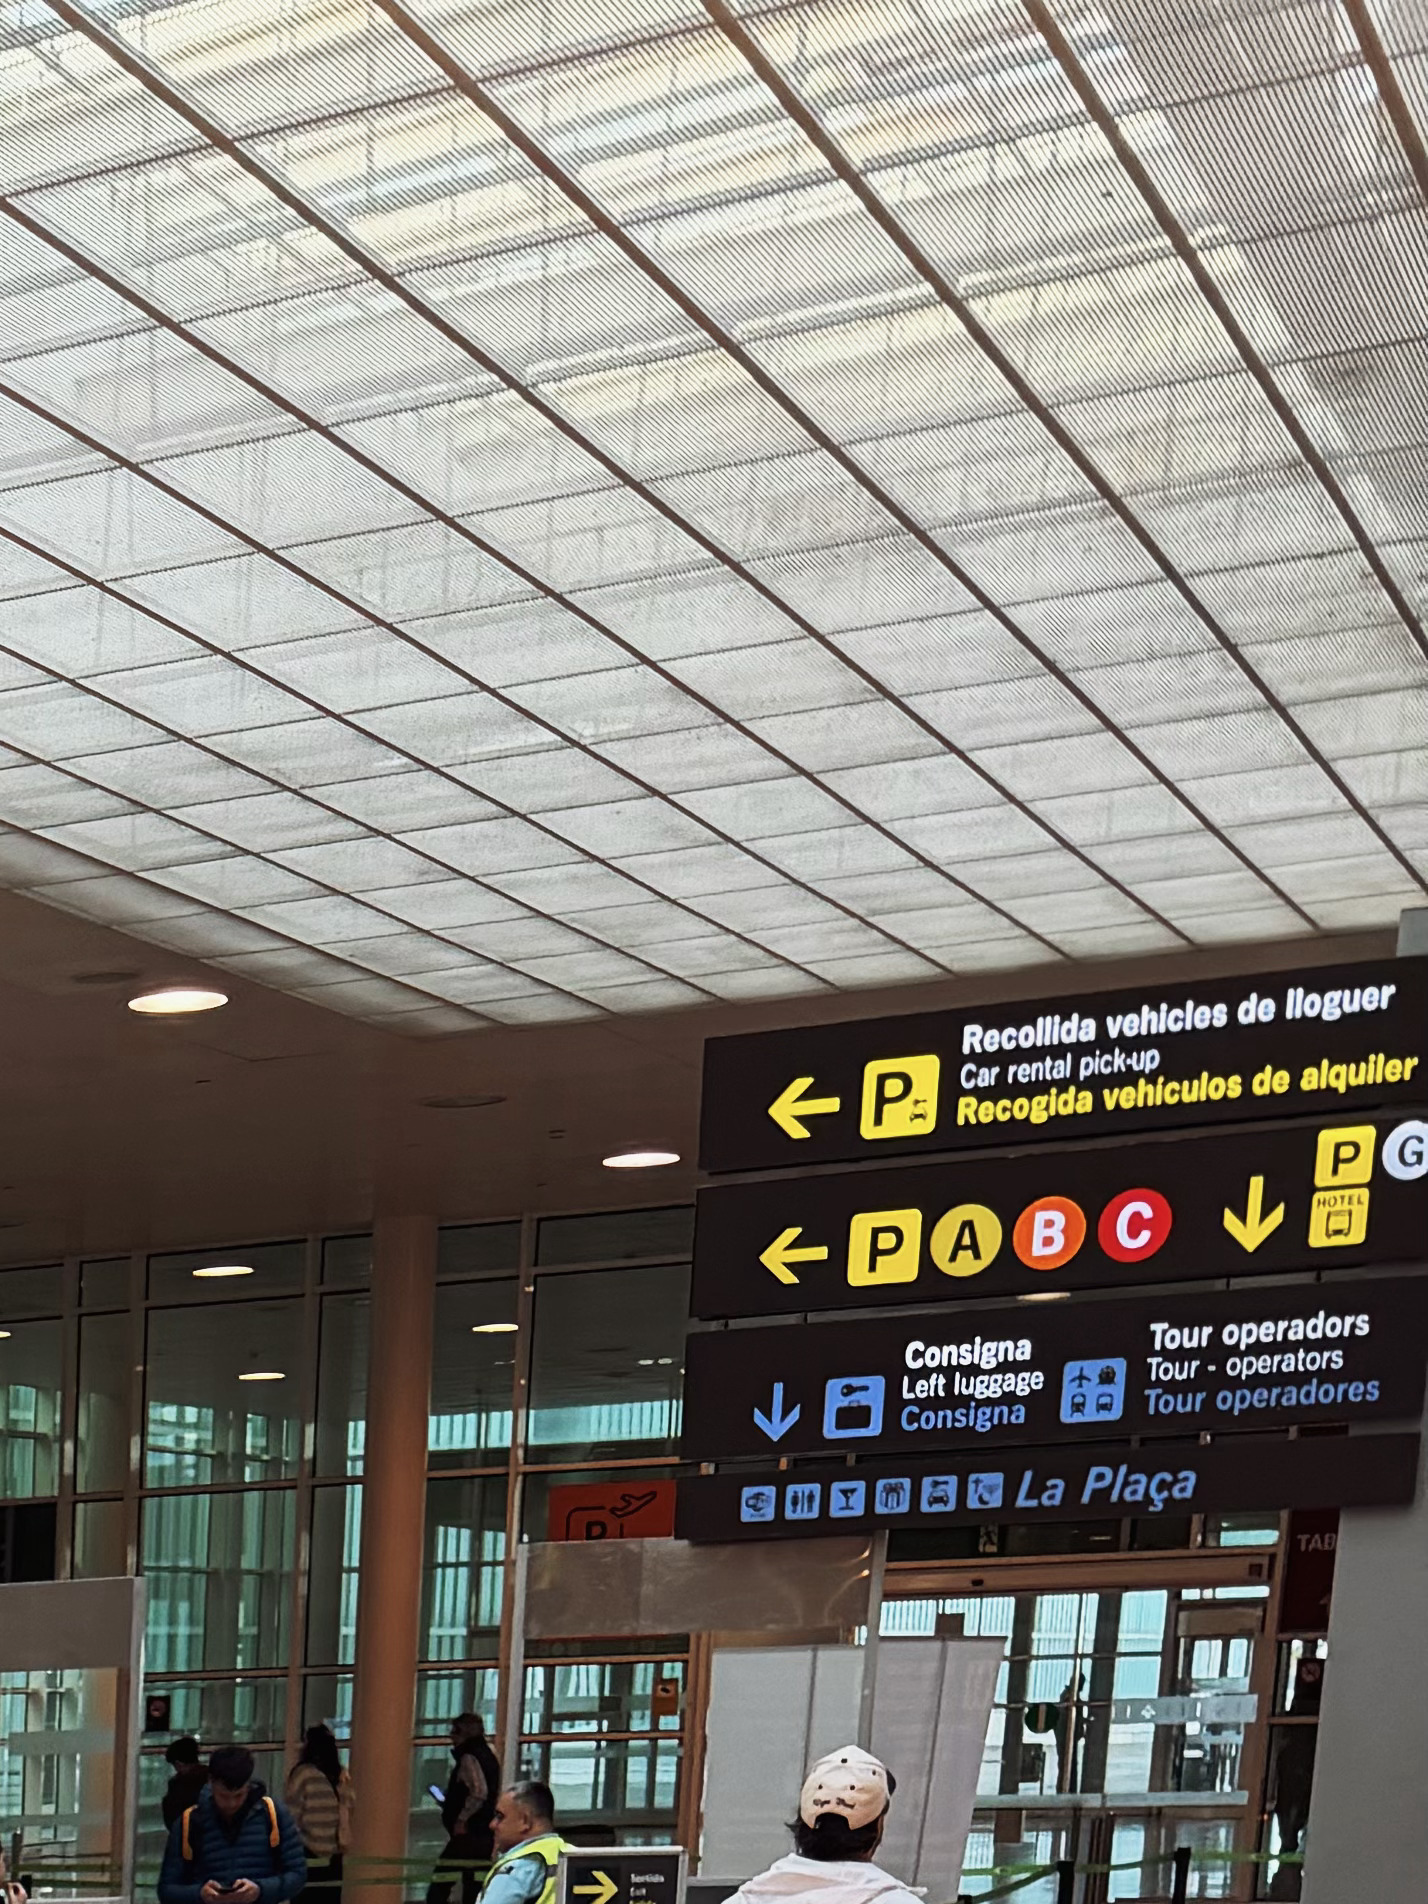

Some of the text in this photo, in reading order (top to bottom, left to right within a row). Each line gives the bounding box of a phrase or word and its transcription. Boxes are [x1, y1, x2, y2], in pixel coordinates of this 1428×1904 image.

[962, 984, 1396, 1055] Recollida vehicles de lloguer
[960, 1046, 1161, 1089] Car rental pick-up
[957, 1053, 1419, 1126] Recogida vehículos de alquiler
[1331, 1135, 1426, 1177] P G
[1317, 1194, 1365, 1208] HOTEL
[868, 1201, 1154, 1273] P A B C
[1149, 1311, 1371, 1352] Tour operadors
[905, 1336, 1033, 1370] Consigna
[1146, 1355, 1203, 1382] Tour
[1224, 1349, 1344, 1380] operators
[902, 1367, 1045, 1400] Left luggage
[1144, 1376, 1381, 1416] Tour operadores
[900, 1400, 1026, 1432] Consigna
[1015, 1464, 1198, 1512] La Plaça
